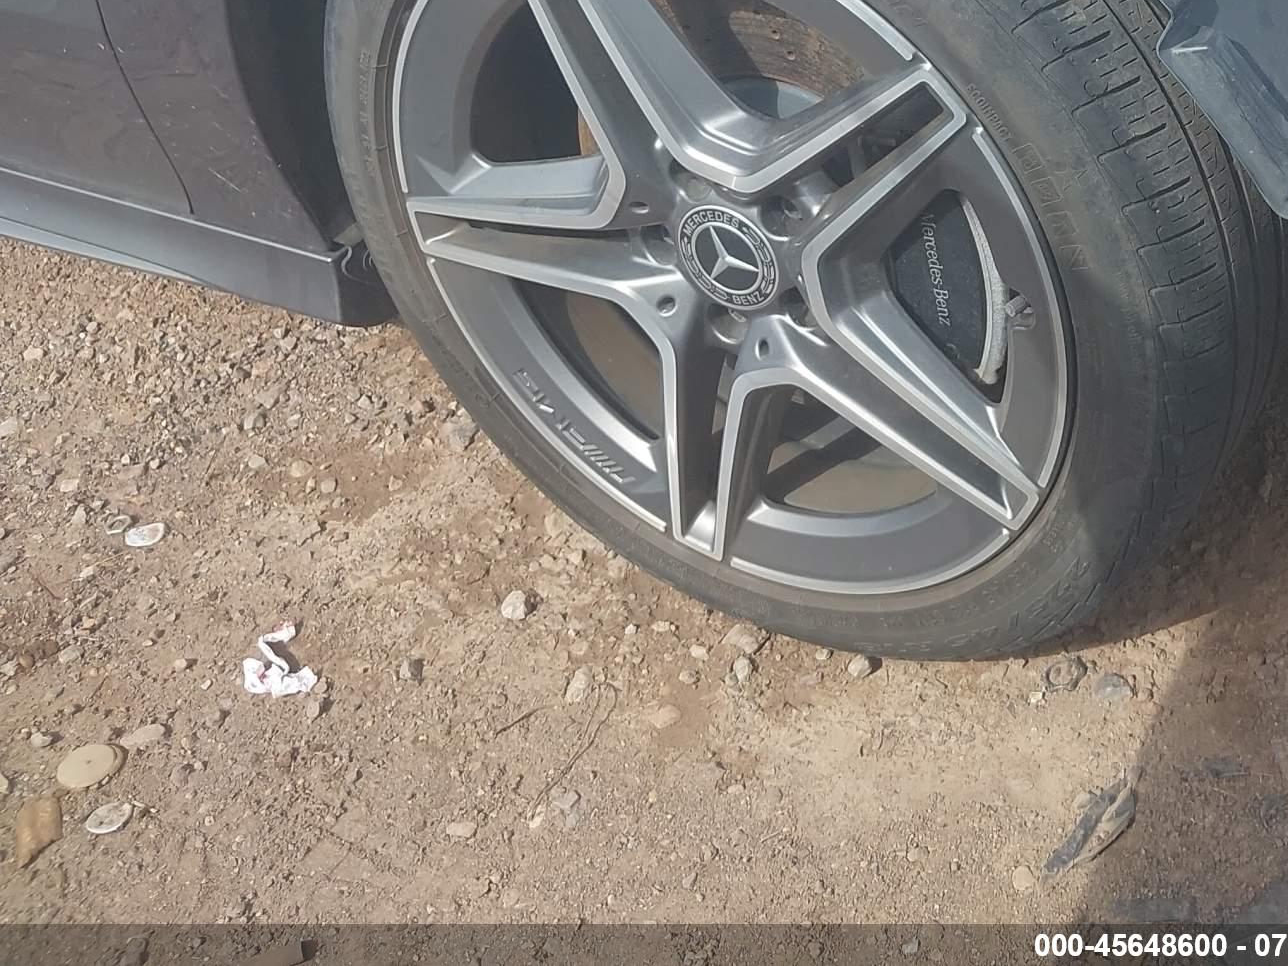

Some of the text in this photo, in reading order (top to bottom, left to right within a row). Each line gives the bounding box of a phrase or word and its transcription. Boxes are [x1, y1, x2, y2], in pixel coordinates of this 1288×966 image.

[683, 211, 740, 236] MERCEDES
[921, 213, 950, 326] Mercedes-Benz
[733, 291, 764, 305] BENZ
